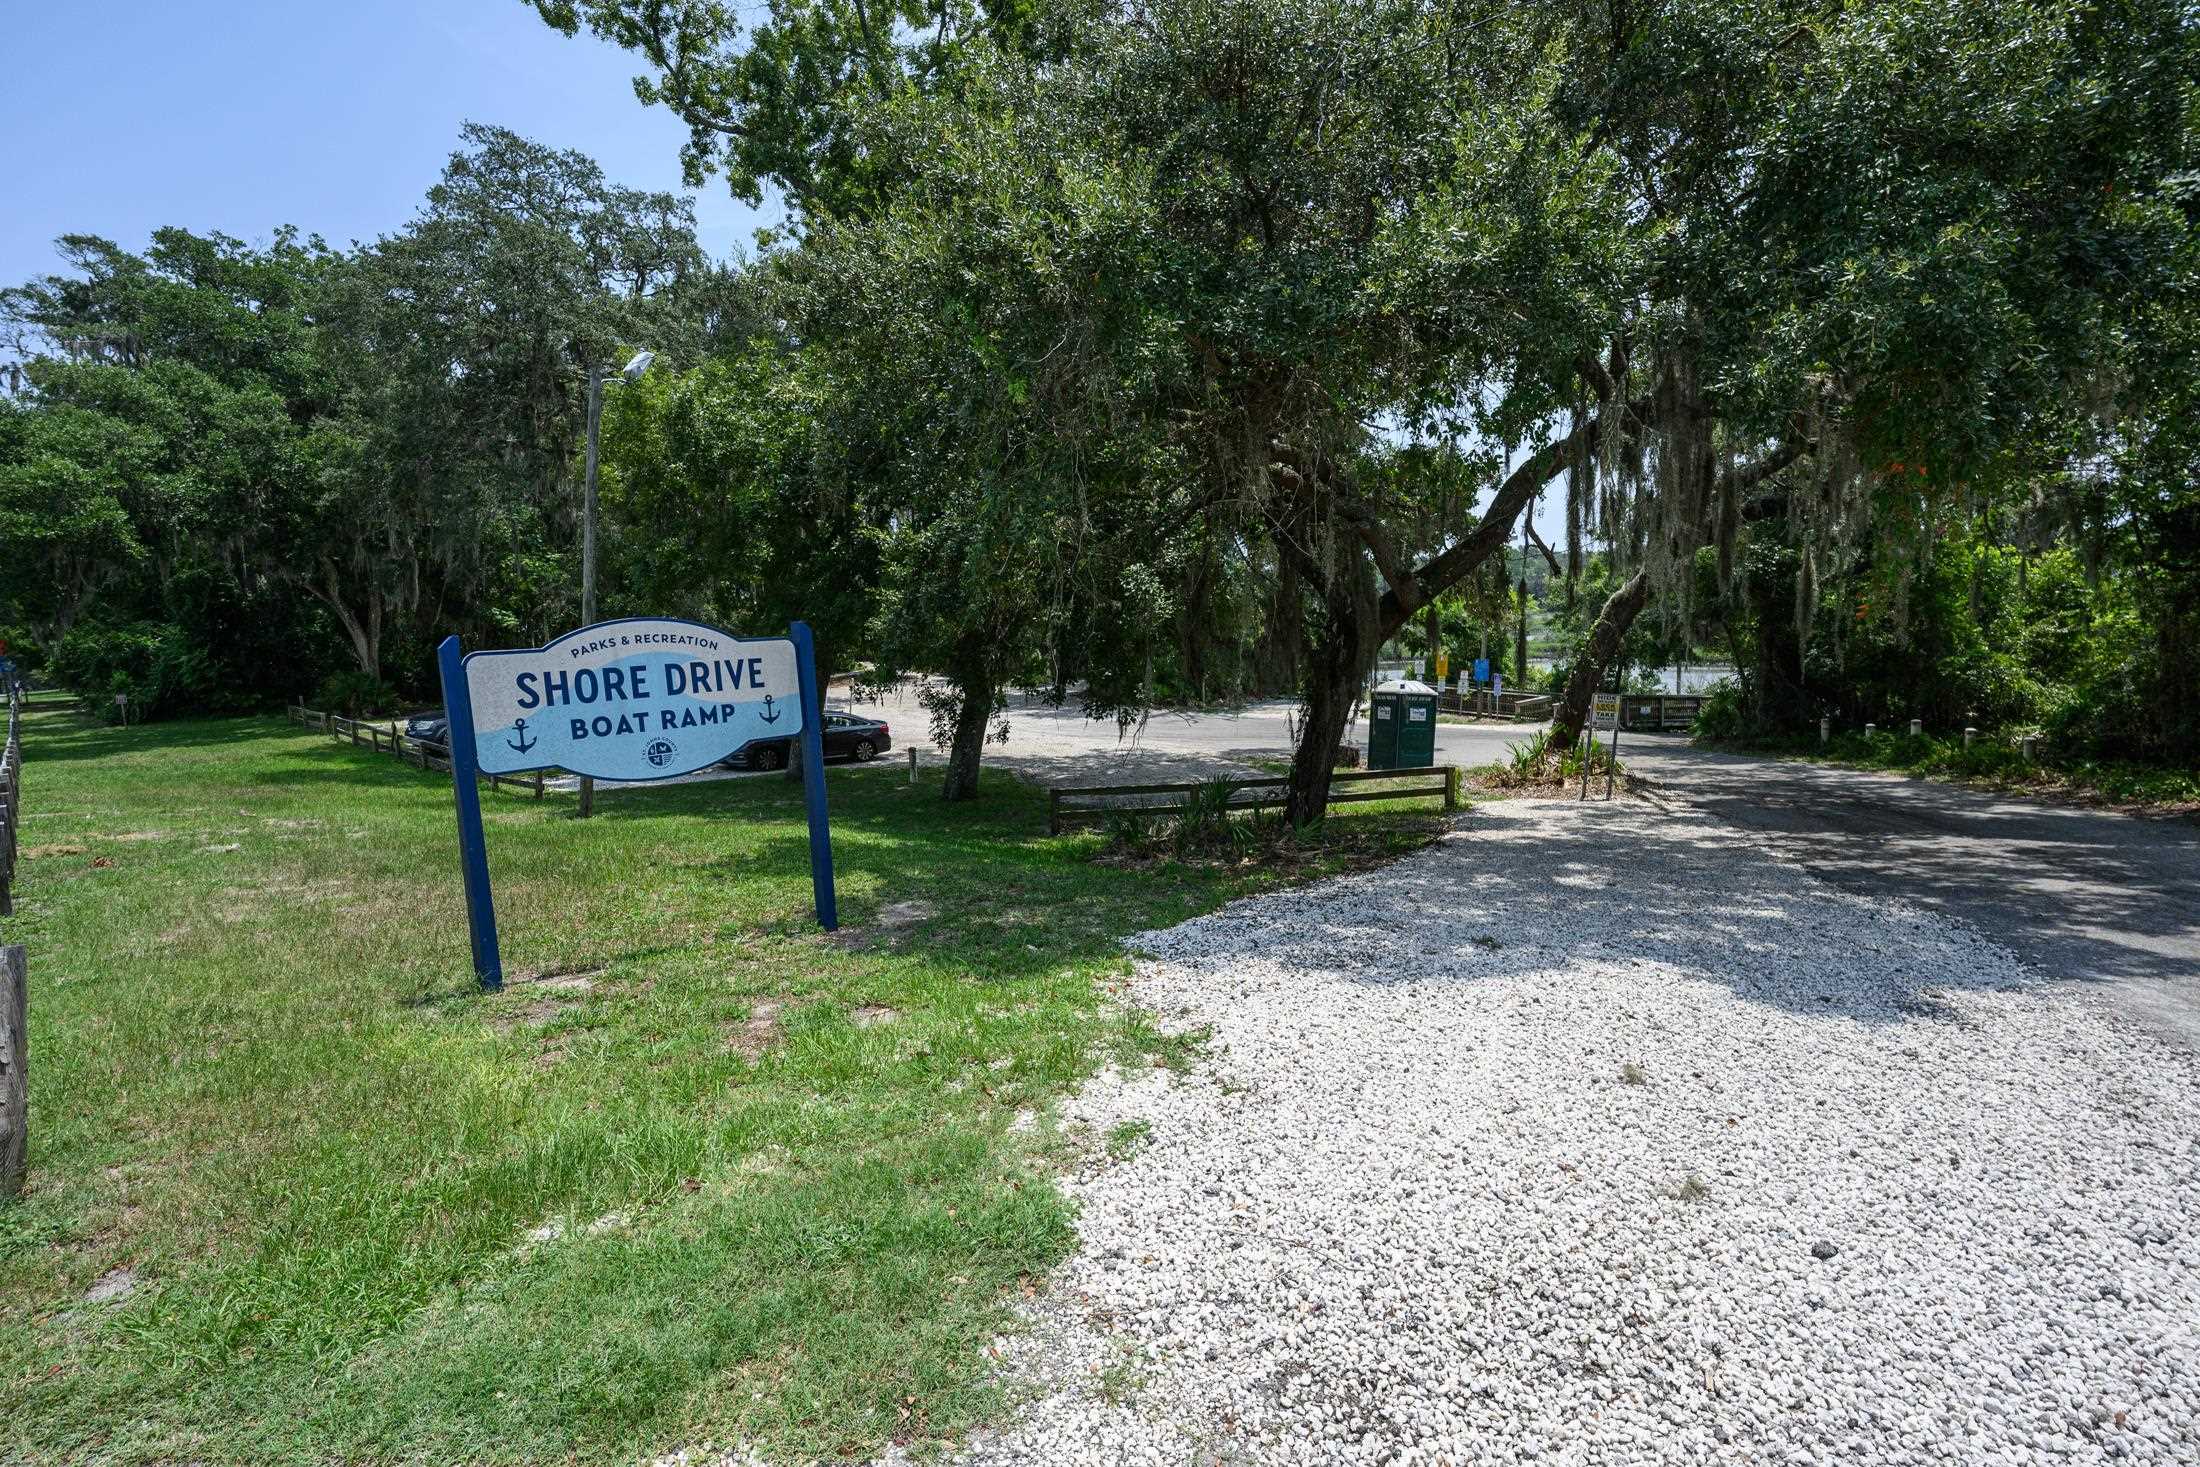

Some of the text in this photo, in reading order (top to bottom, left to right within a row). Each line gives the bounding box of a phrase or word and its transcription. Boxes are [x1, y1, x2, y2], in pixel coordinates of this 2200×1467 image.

[571, 633, 718, 658] PARKS & RECREATION
[516, 658, 765, 708] SHORE DRIVE
[570, 704, 735, 740] BOAT RAMP
